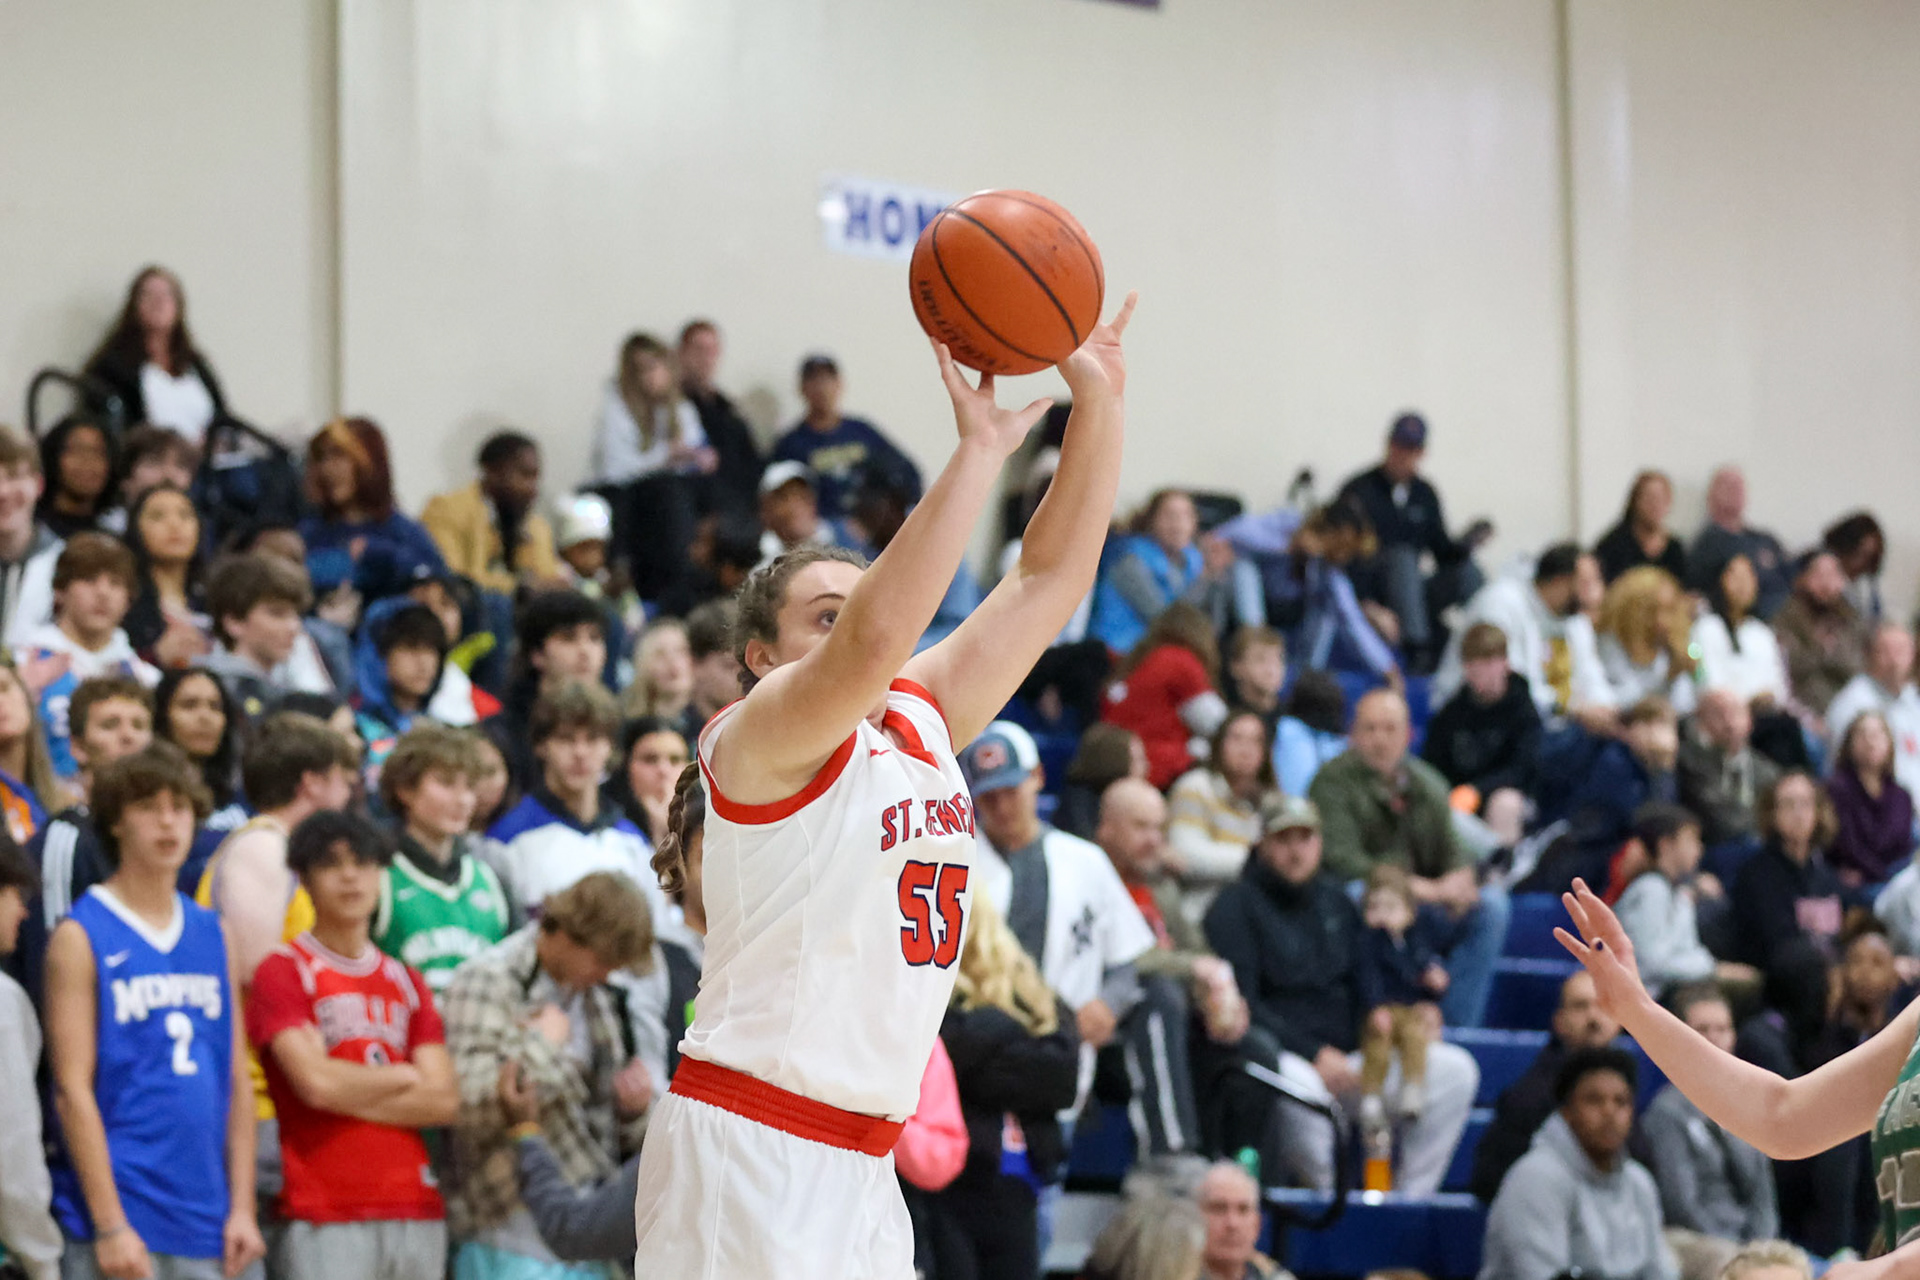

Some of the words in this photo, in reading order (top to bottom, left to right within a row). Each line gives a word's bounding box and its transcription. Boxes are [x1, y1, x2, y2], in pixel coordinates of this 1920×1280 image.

[880, 797, 922, 852] ST.
[897, 859, 969, 970] 55
[165, 1010, 197, 1075] 2
